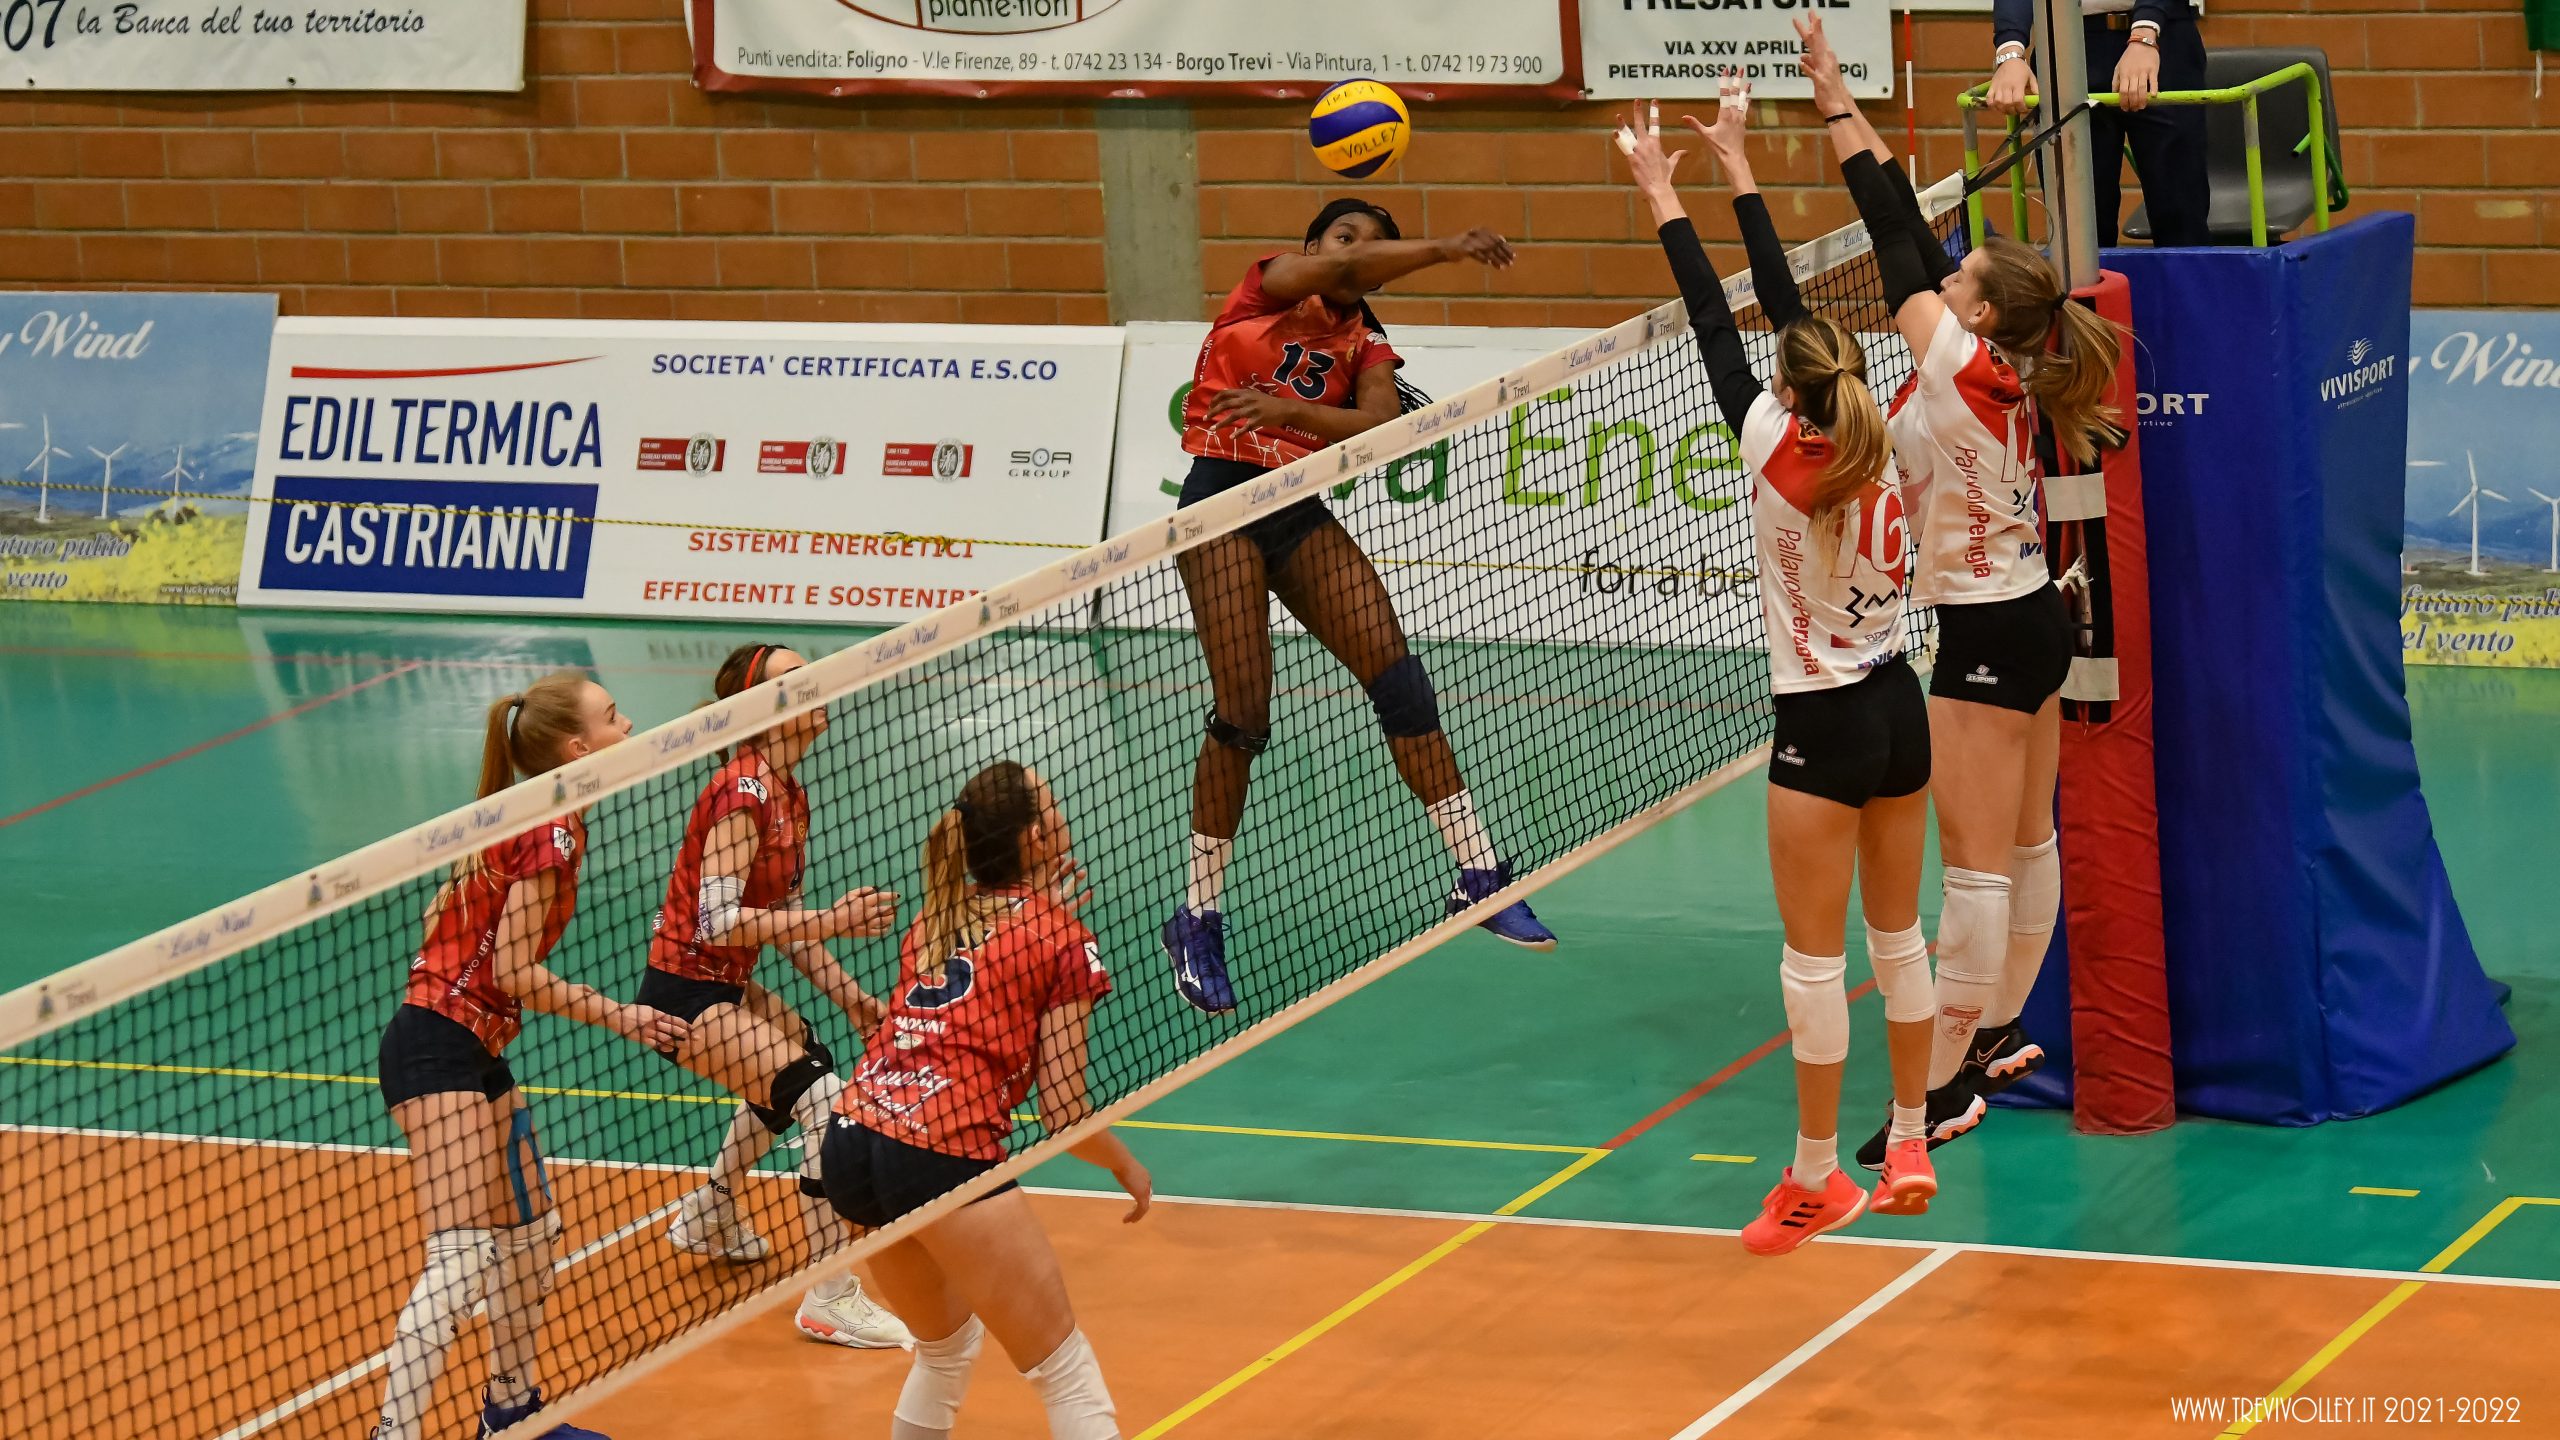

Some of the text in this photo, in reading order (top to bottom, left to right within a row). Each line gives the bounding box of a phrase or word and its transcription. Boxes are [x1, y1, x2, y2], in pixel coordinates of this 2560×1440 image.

[76, 6, 102, 34] la
[113, 4, 190, 35] Banca
[201, 6, 240, 34] del
[252, 9, 294, 34] tuo
[304, 8, 425, 35] territorio
[738, 46, 772, 68] Punti
[776, 49, 842, 69] vendita:
[846, 50, 908, 73] Foligno
[922, 50, 950, 70] V.le
[955, 51, 1014, 73] Firenze,
[1018, 53, 1038, 71] 89
[1051, 55, 1059, 71] t.
[1064, 53, 1103, 71] 0742
[1107, 53, 1128, 71] 23
[1132, 53, 1163, 71] 134
[1176, 52, 1226, 76] Borgo
[1228, 52, 1273, 72] Trevi
[1286, 52, 1312, 71] Via
[1315, 53, 1377, 75] Pintura,
[1381, 54, 1389, 72] 1
[1405, 56, 1417, 73] t.
[1421, 55, 1462, 73] 0742
[1467, 55, 1485, 73] 19
[1490, 55, 1509, 73] 73
[1513, 54, 1543, 74] 900
[1664, 40, 1812, 55] VIA XXV APRILE
[1608, 63, 1739, 79] PIETRAROSSA
[1746, 64, 1767, 78] DI
[1326, 84, 1375, 107] TREVI
[1341, 121, 1398, 159] VOLLEY
[20, 310, 155, 359] Wind
[651, 353, 1058, 381] SOCIETA' CERTIFICATA E.S.CO
[1272, 340, 1336, 401] 13
[2320, 354, 2396, 402] VIVISPORT
[279, 395, 602, 468] EDILTERMICA
[1008, 468, 1072, 478] GROUP
[0, 532, 131, 562] turo pulito
[284, 500, 574, 571] CASTRIANNI
[688, 531, 974, 559] SISTEMI ENERGETICI
[7, 570, 68, 589] vento
[1580, 549, 1643, 594] for
[1656, 564, 1679, 597] a
[642, 580, 796, 604] EFFICIENTI
[804, 585, 819, 605] E
[2436, 629, 2516, 652] vento
